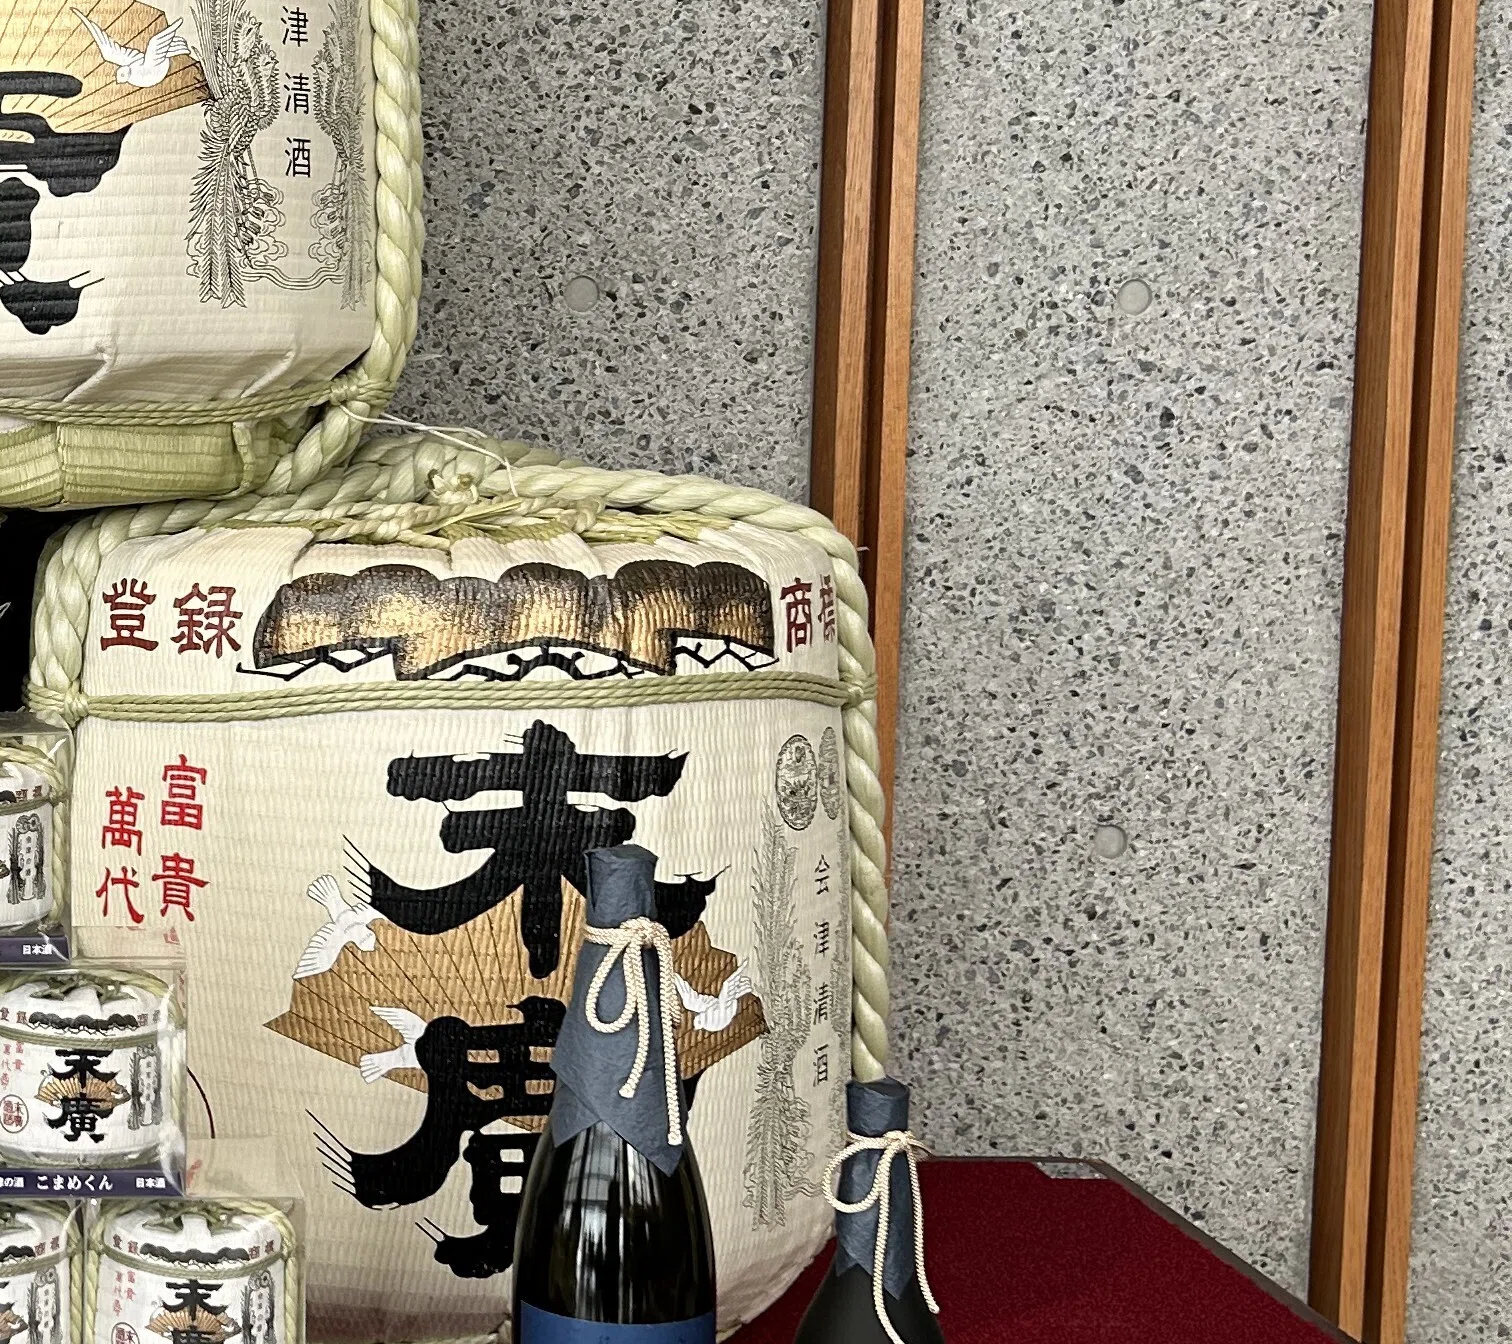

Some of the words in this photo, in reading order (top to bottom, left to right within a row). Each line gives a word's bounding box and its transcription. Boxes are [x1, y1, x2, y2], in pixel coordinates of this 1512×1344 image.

[99, 579, 243, 657] 登録
[150, 753, 210, 923] 富貴
[37, 1174, 113, 1192] こまめくん
